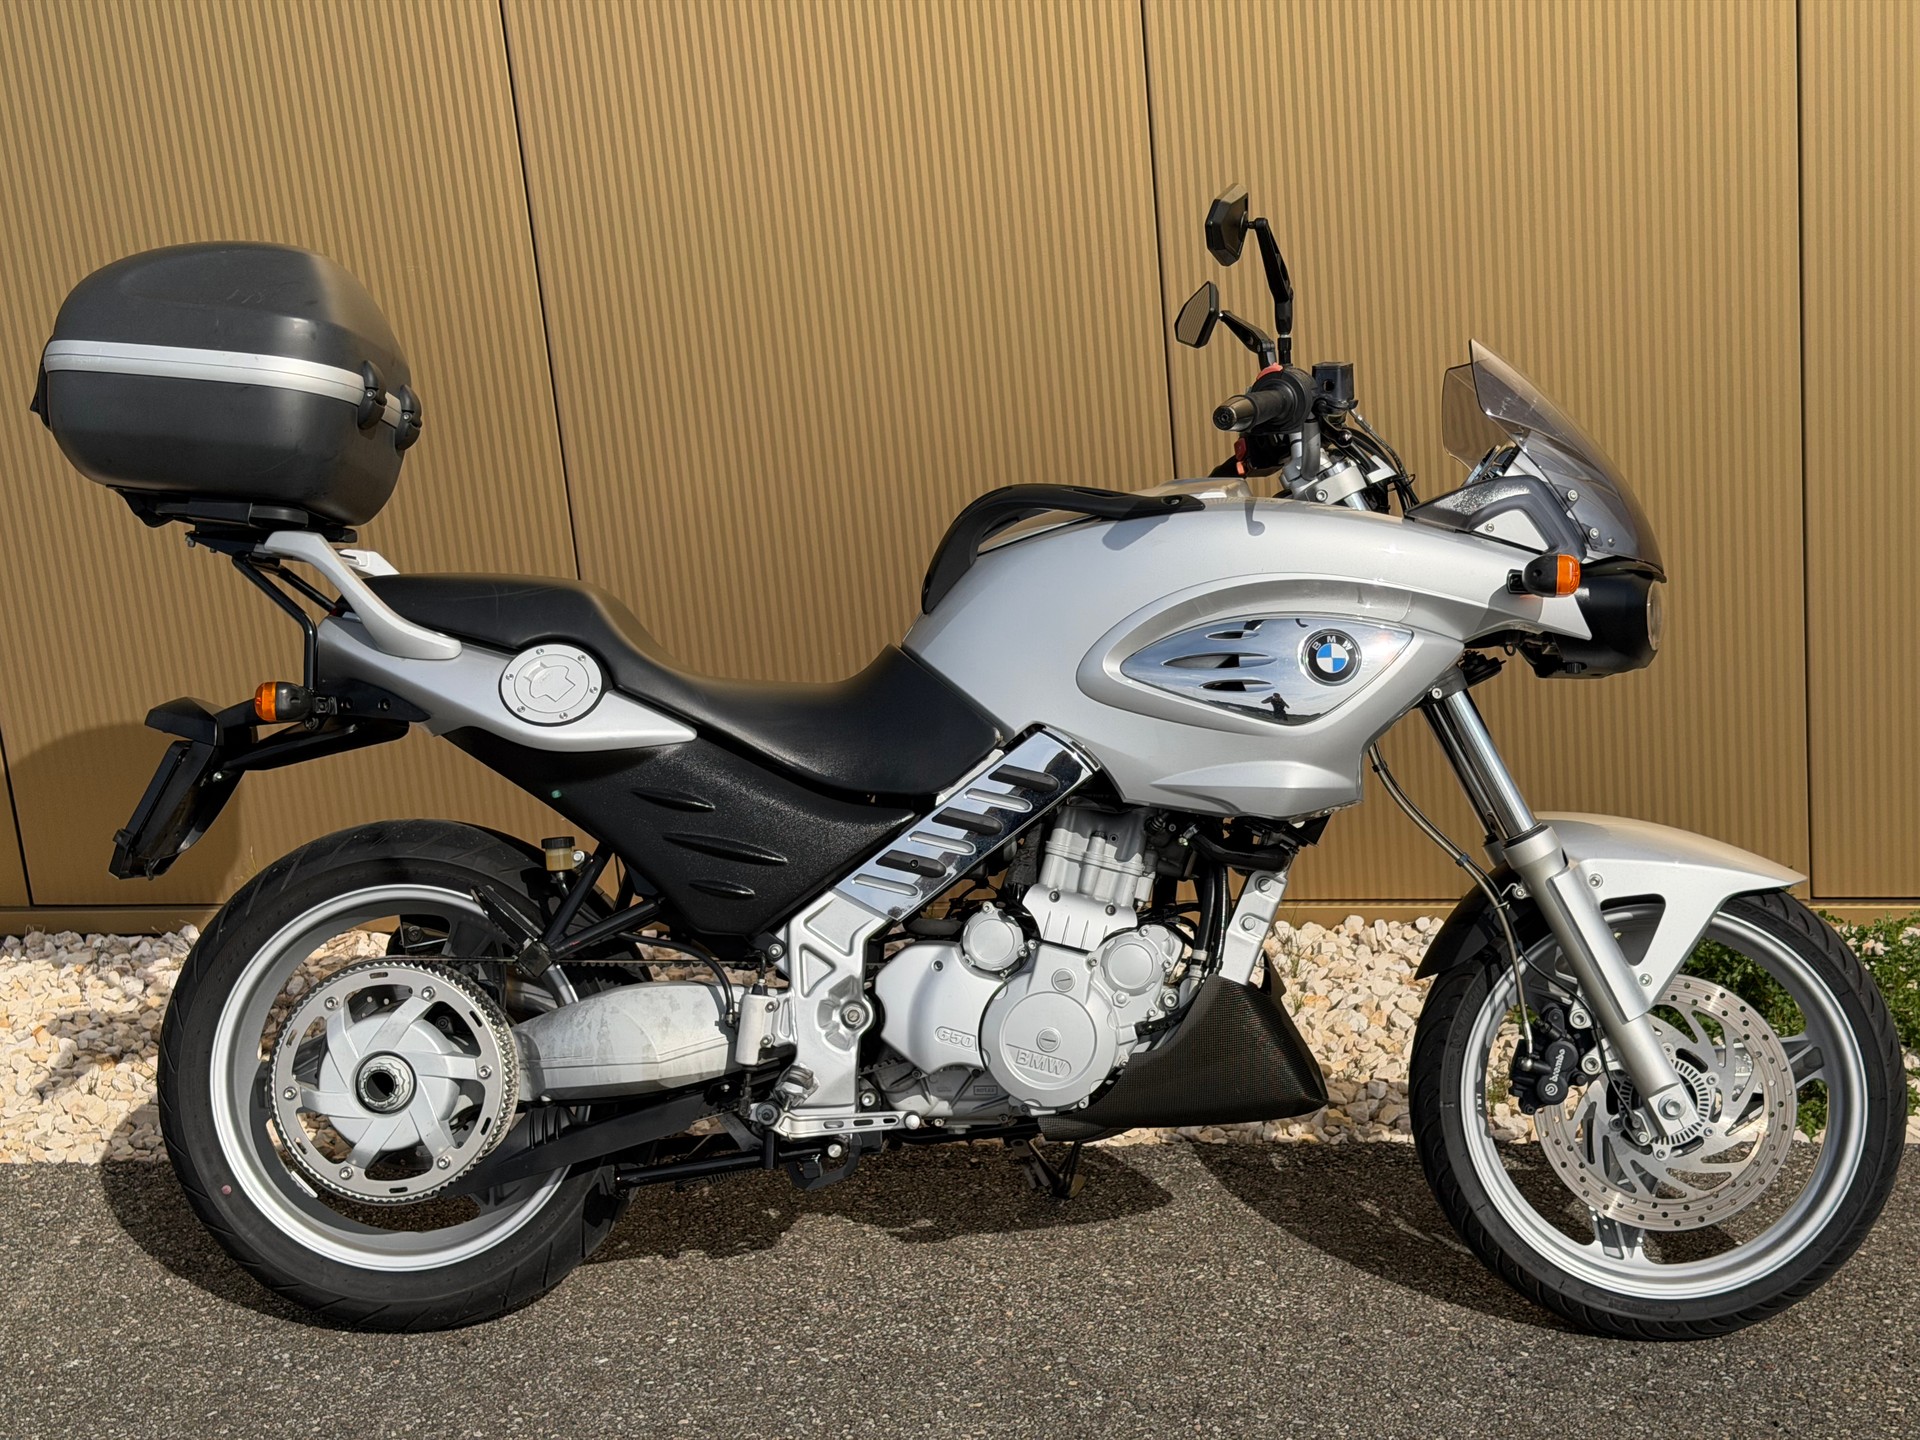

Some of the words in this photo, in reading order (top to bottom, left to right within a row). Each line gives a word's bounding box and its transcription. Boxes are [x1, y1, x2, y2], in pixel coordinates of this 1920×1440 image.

[1312, 636, 1353, 650] BMW
[937, 1029, 974, 1048] 650
[1015, 1049, 1066, 1075] BMW
[1549, 1048, 1565, 1082] brembo
